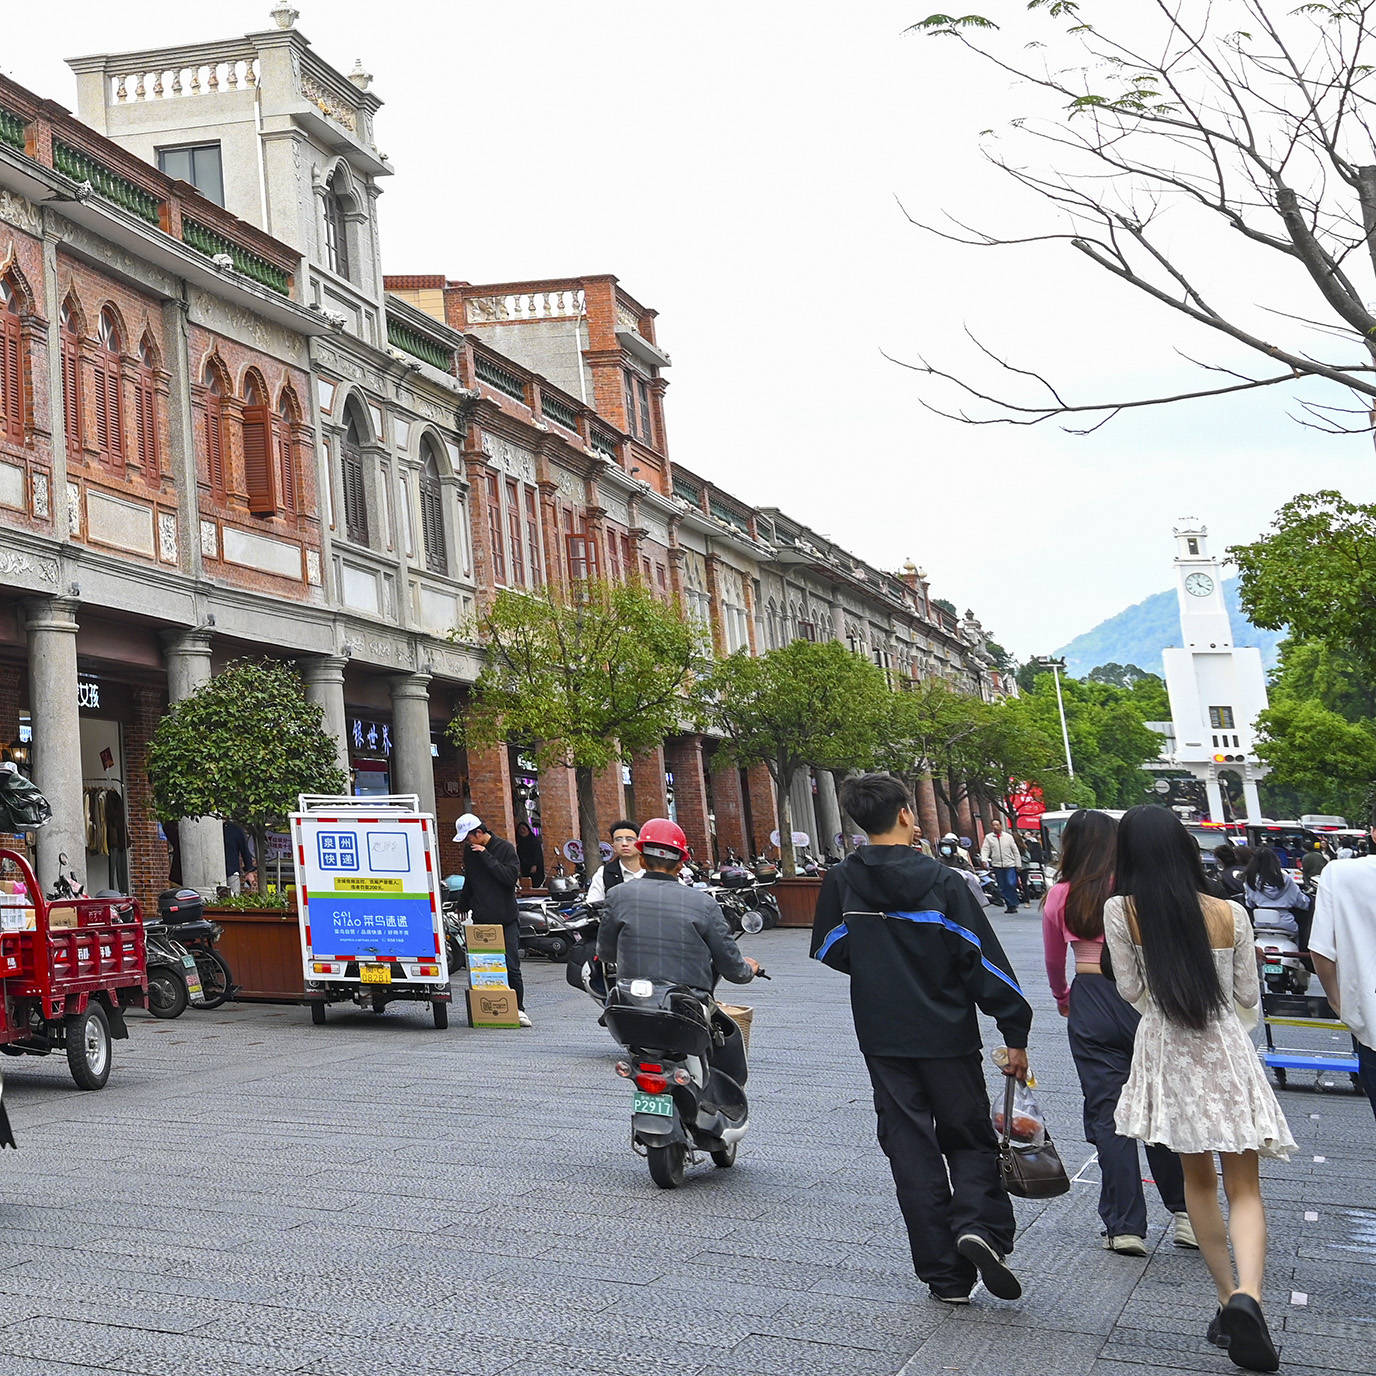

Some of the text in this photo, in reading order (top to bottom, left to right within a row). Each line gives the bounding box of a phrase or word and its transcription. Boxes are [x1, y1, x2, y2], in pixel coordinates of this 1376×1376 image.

[323, 836, 352, 849] 泉州
[325, 853, 353, 865] 快递
[333, 911, 350, 919] CAI
[363, 915, 408, 927] 菜鸟速递
[333, 918, 362, 927] NIAO
[634, 1099, 671, 1114] P2917
